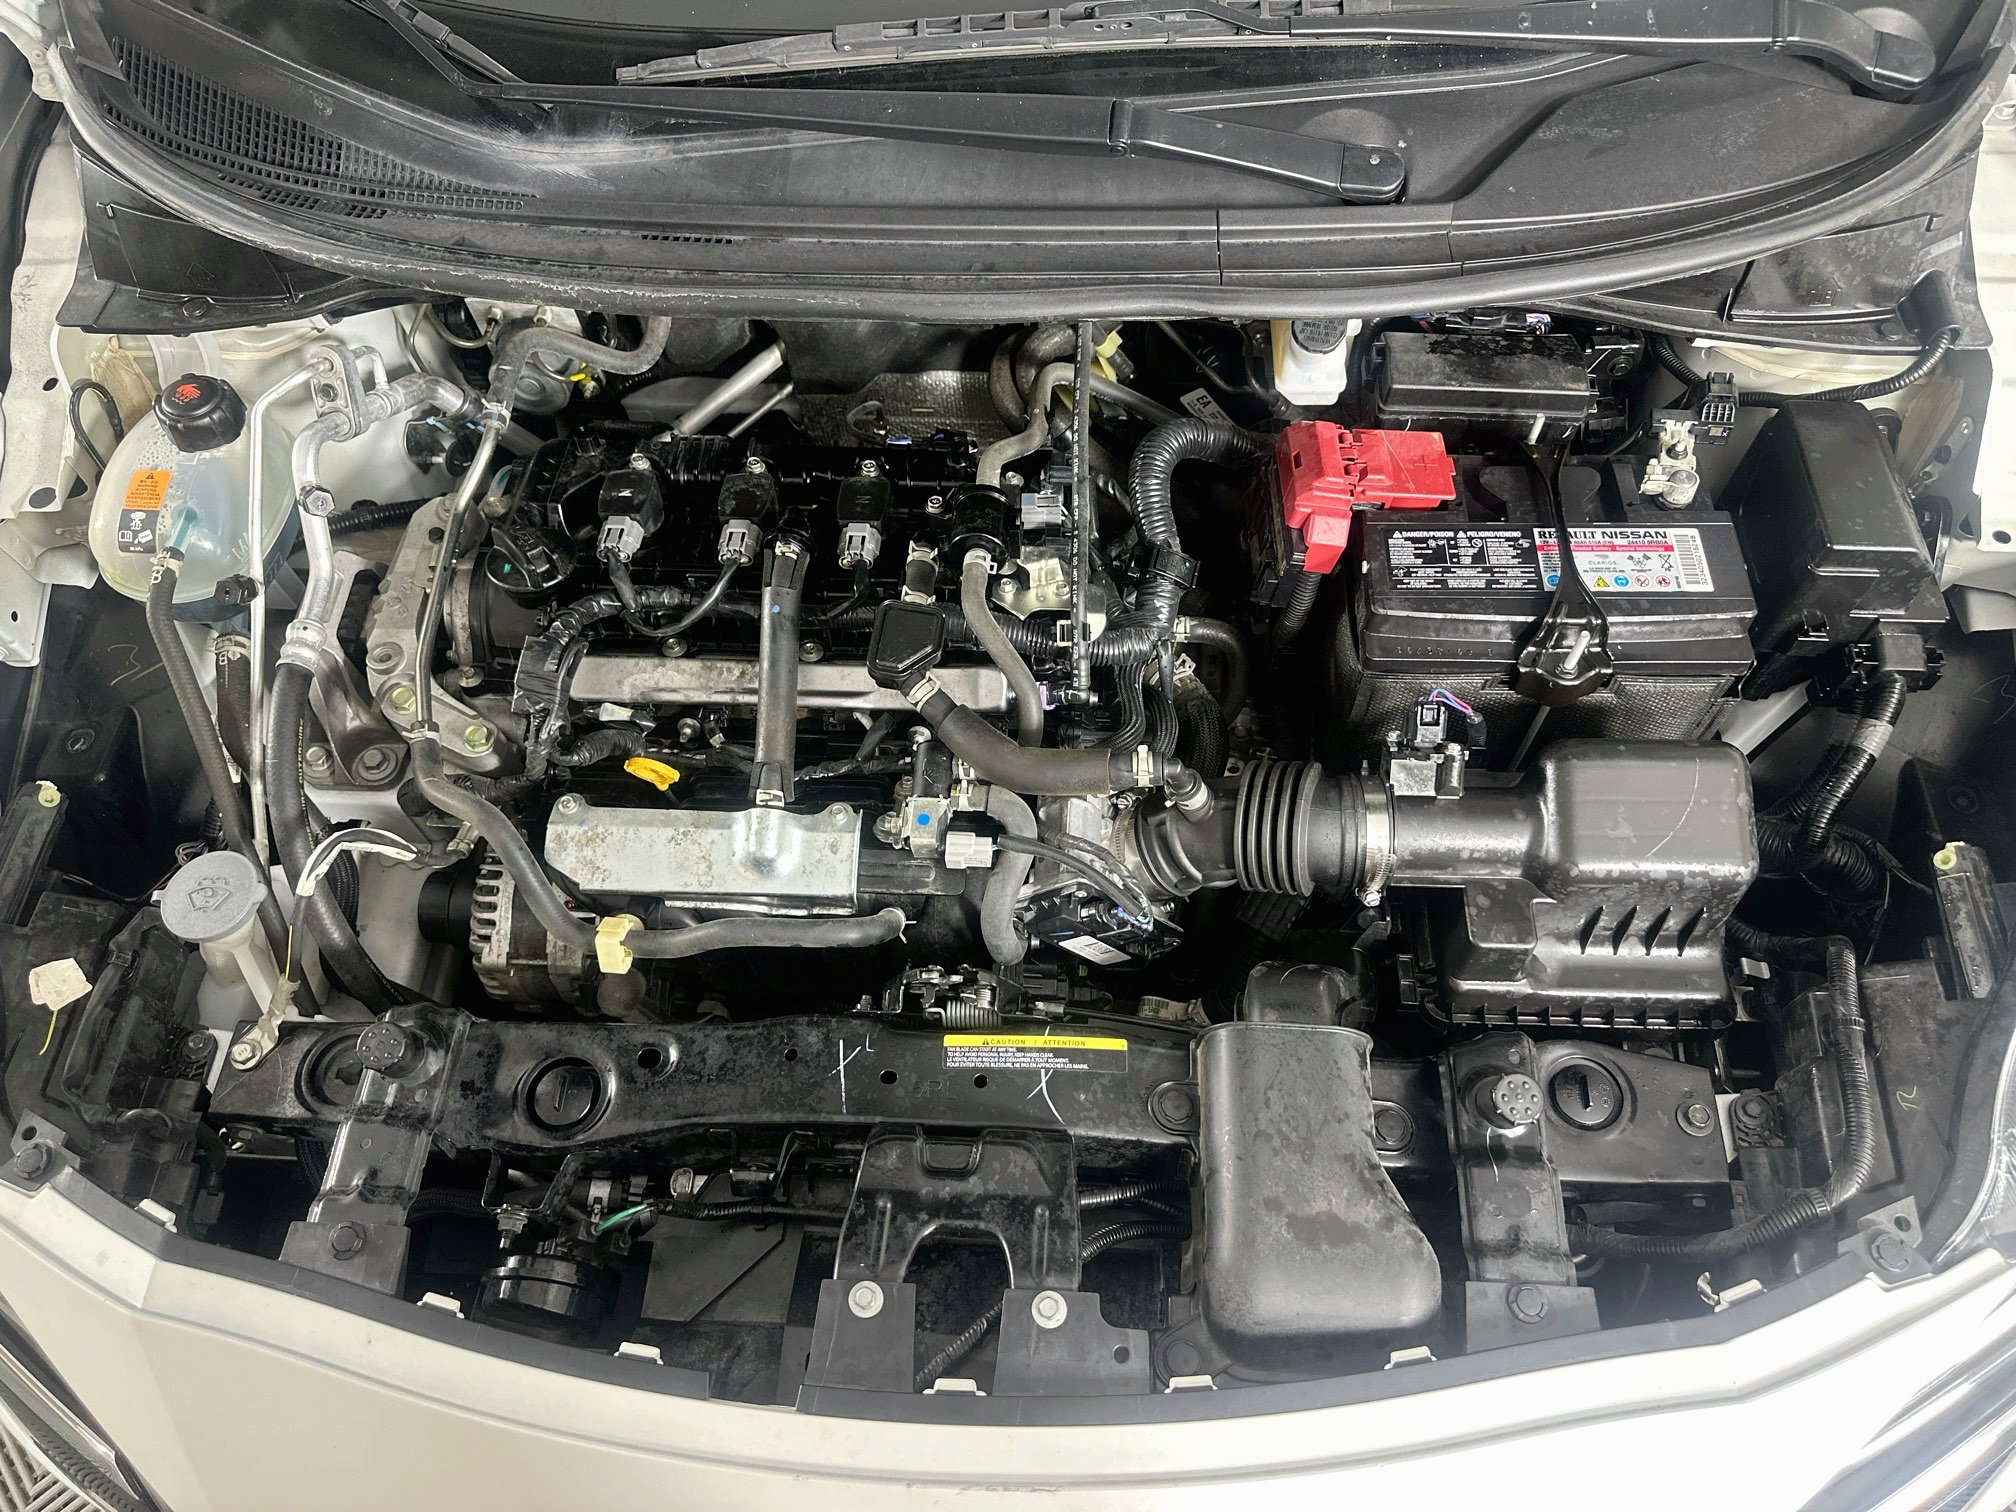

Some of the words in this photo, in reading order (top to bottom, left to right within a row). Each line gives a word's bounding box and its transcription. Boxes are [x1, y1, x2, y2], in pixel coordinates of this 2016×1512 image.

[1196, 395, 1212, 409] EA
[1538, 531, 1596, 539] REAULT
[1601, 531, 1667, 539] NISSAN
